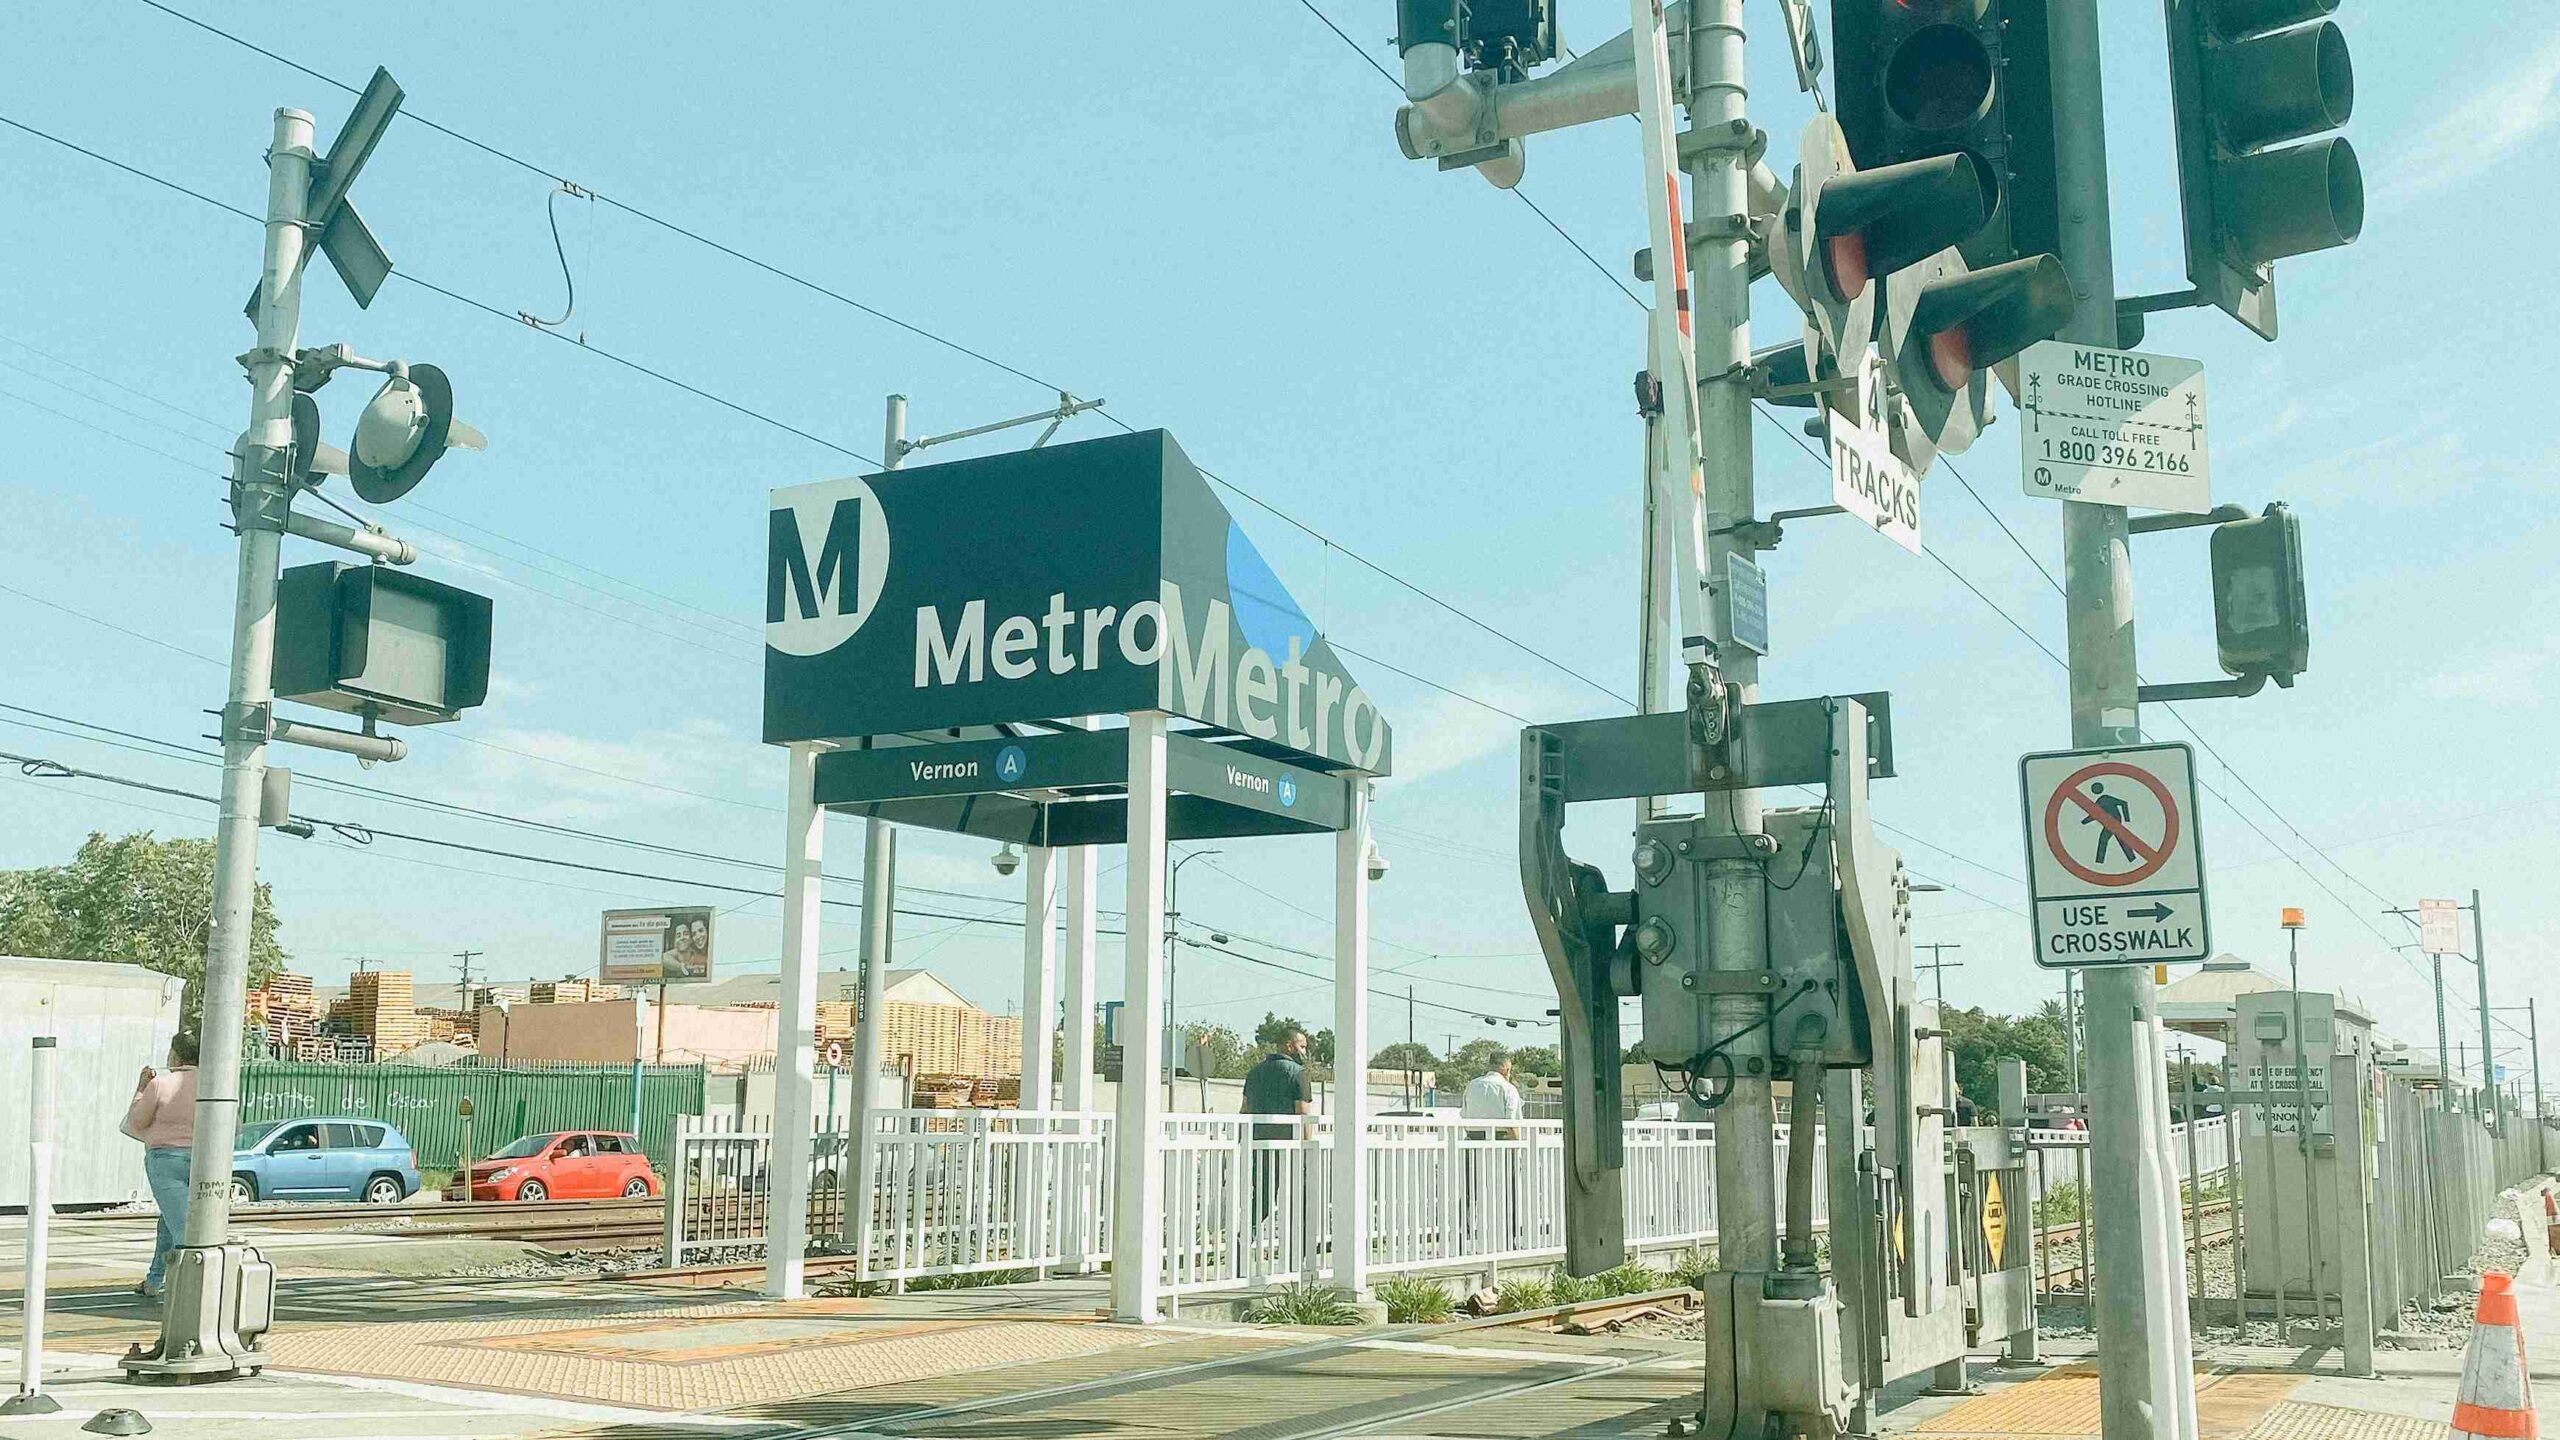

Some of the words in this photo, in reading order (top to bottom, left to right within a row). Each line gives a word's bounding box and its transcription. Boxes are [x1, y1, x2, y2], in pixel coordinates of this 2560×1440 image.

[2074, 350, 2150, 378] METRO
[2057, 373, 2101, 390] GRADE
[2104, 379, 2170, 398] CROSSING
[2086, 394, 2143, 413] HOTLINE
[2071, 426, 2099, 440] CALL
[2102, 429, 2130, 443] TOLL
[2132, 433, 2161, 446] FREE
[2042, 438, 2051, 458] 1
[2059, 440, 2096, 462] 800
[2102, 445, 2138, 467] 396
[2143, 450, 2190, 473] 2166
[1835, 436, 1917, 531] TRACKS
[2054, 483, 2082, 495] Metro
[766, 496, 862, 624] M
[914, 592, 1168, 688] Metro
[1160, 578, 1385, 769] Metro
[910, 757, 979, 782] Vernon
[1002, 754, 1019, 773] A
[1226, 764, 1271, 795] Vernon
[2063, 905, 2109, 927] USE
[2050, 927, 2194, 954] CROSSWALK
[2250, 1080, 2258, 1089] AT
[2258, 1080, 2274, 1089] TS
[2256, 1067, 2275, 1077] CE
[341, 1084, 368, 1110] de
